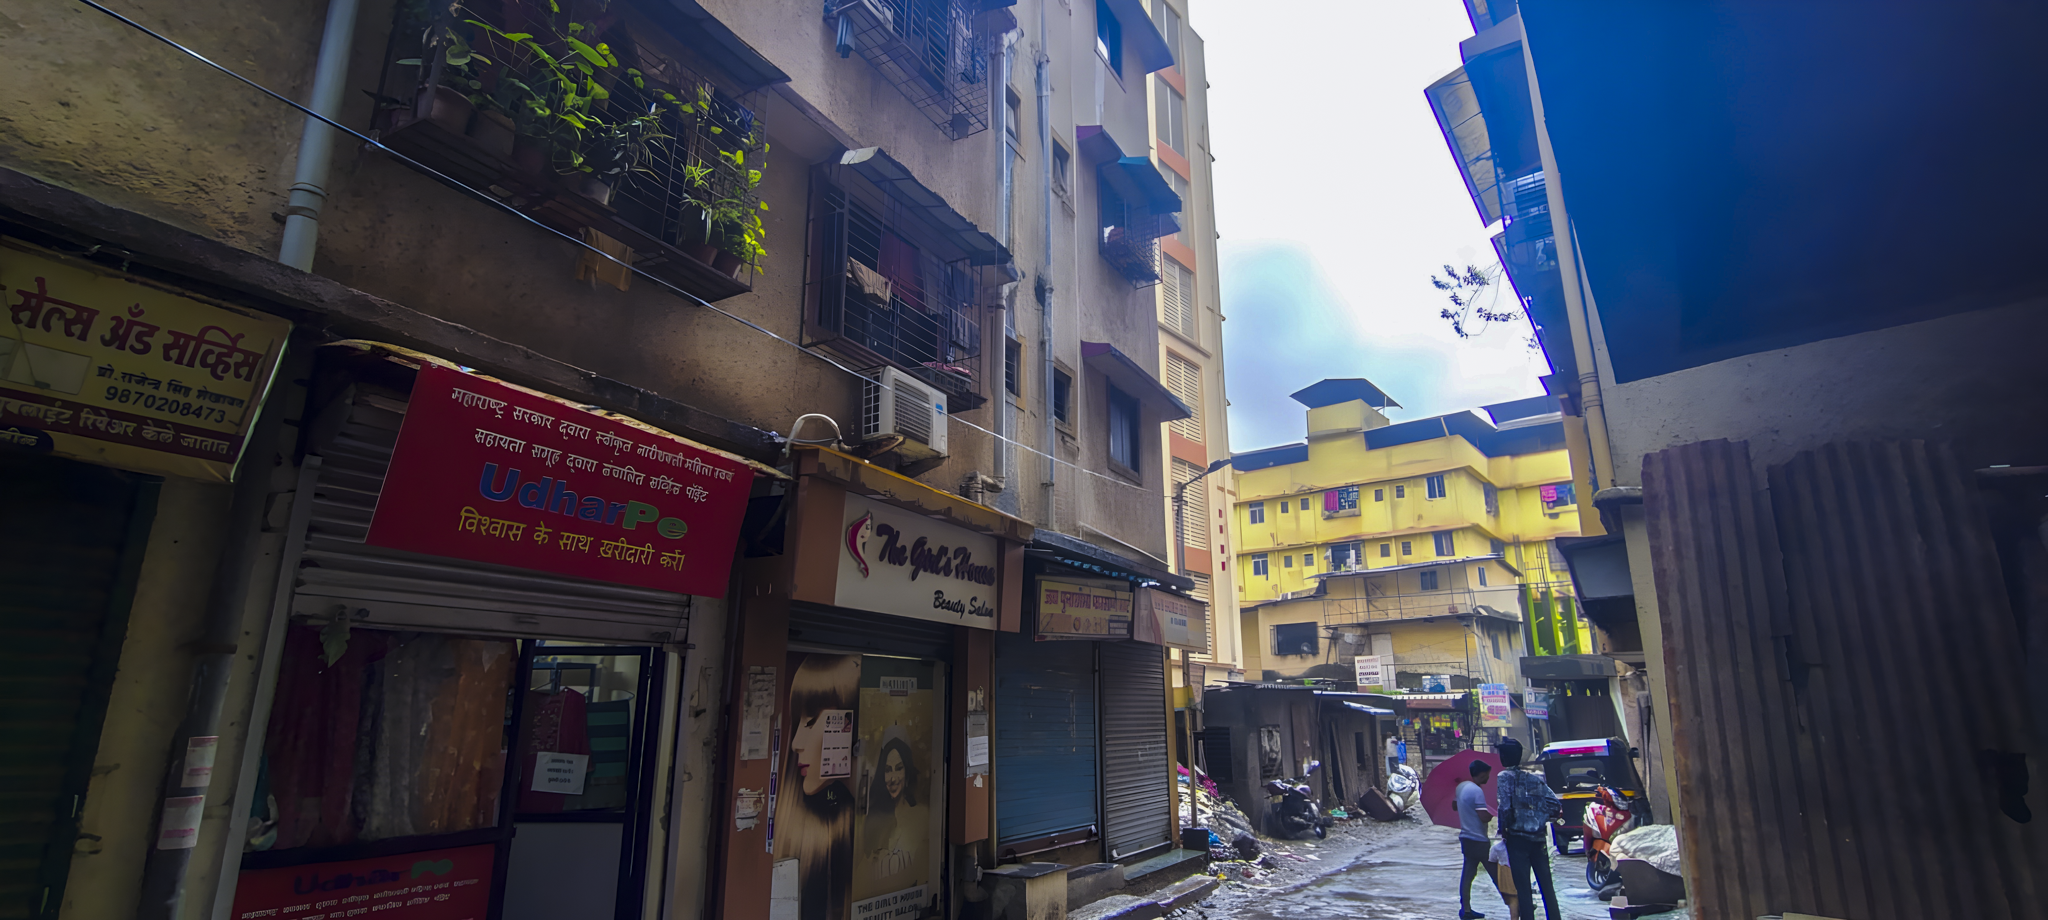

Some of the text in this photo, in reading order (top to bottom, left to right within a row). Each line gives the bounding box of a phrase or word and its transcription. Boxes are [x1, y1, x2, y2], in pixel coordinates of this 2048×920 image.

[10, 276, 100, 341] सेल्स
[162, 325, 264, 382] सर्व्हिस
[105, 386, 226, 423] 9870208473
[451, 387, 508, 419] महाराष्ट्र
[513, 406, 555, 429] सरकार
[474, 428, 527, 453] सहायता
[479, 461, 688, 540] UdharPe
[458, 506, 527, 541] विश्वास
[533, 521, 552, 545] के
[558, 531, 594, 553] साथ
[876, 524, 908, 566] The
[933, 590, 965, 619] Beauty
